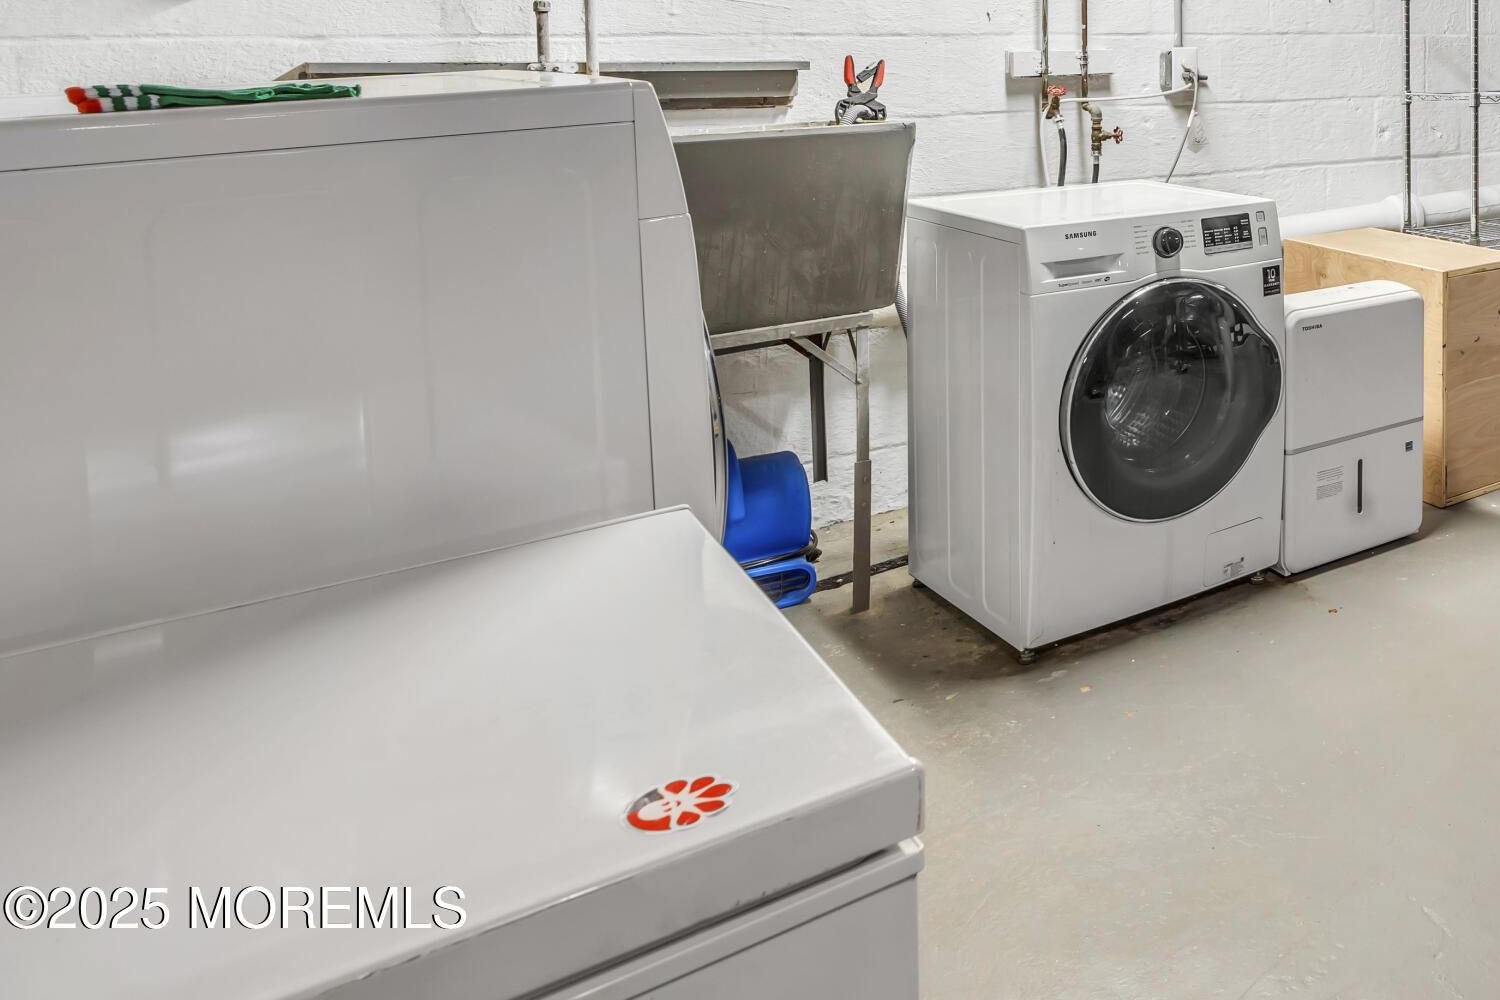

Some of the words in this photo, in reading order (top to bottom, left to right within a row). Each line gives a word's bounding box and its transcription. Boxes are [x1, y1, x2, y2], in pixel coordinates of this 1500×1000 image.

[1064, 230, 1097, 240] SAMSUNG
[1266, 268, 1276, 279] 10
[1301, 323, 1323, 332] TOSHIBA
